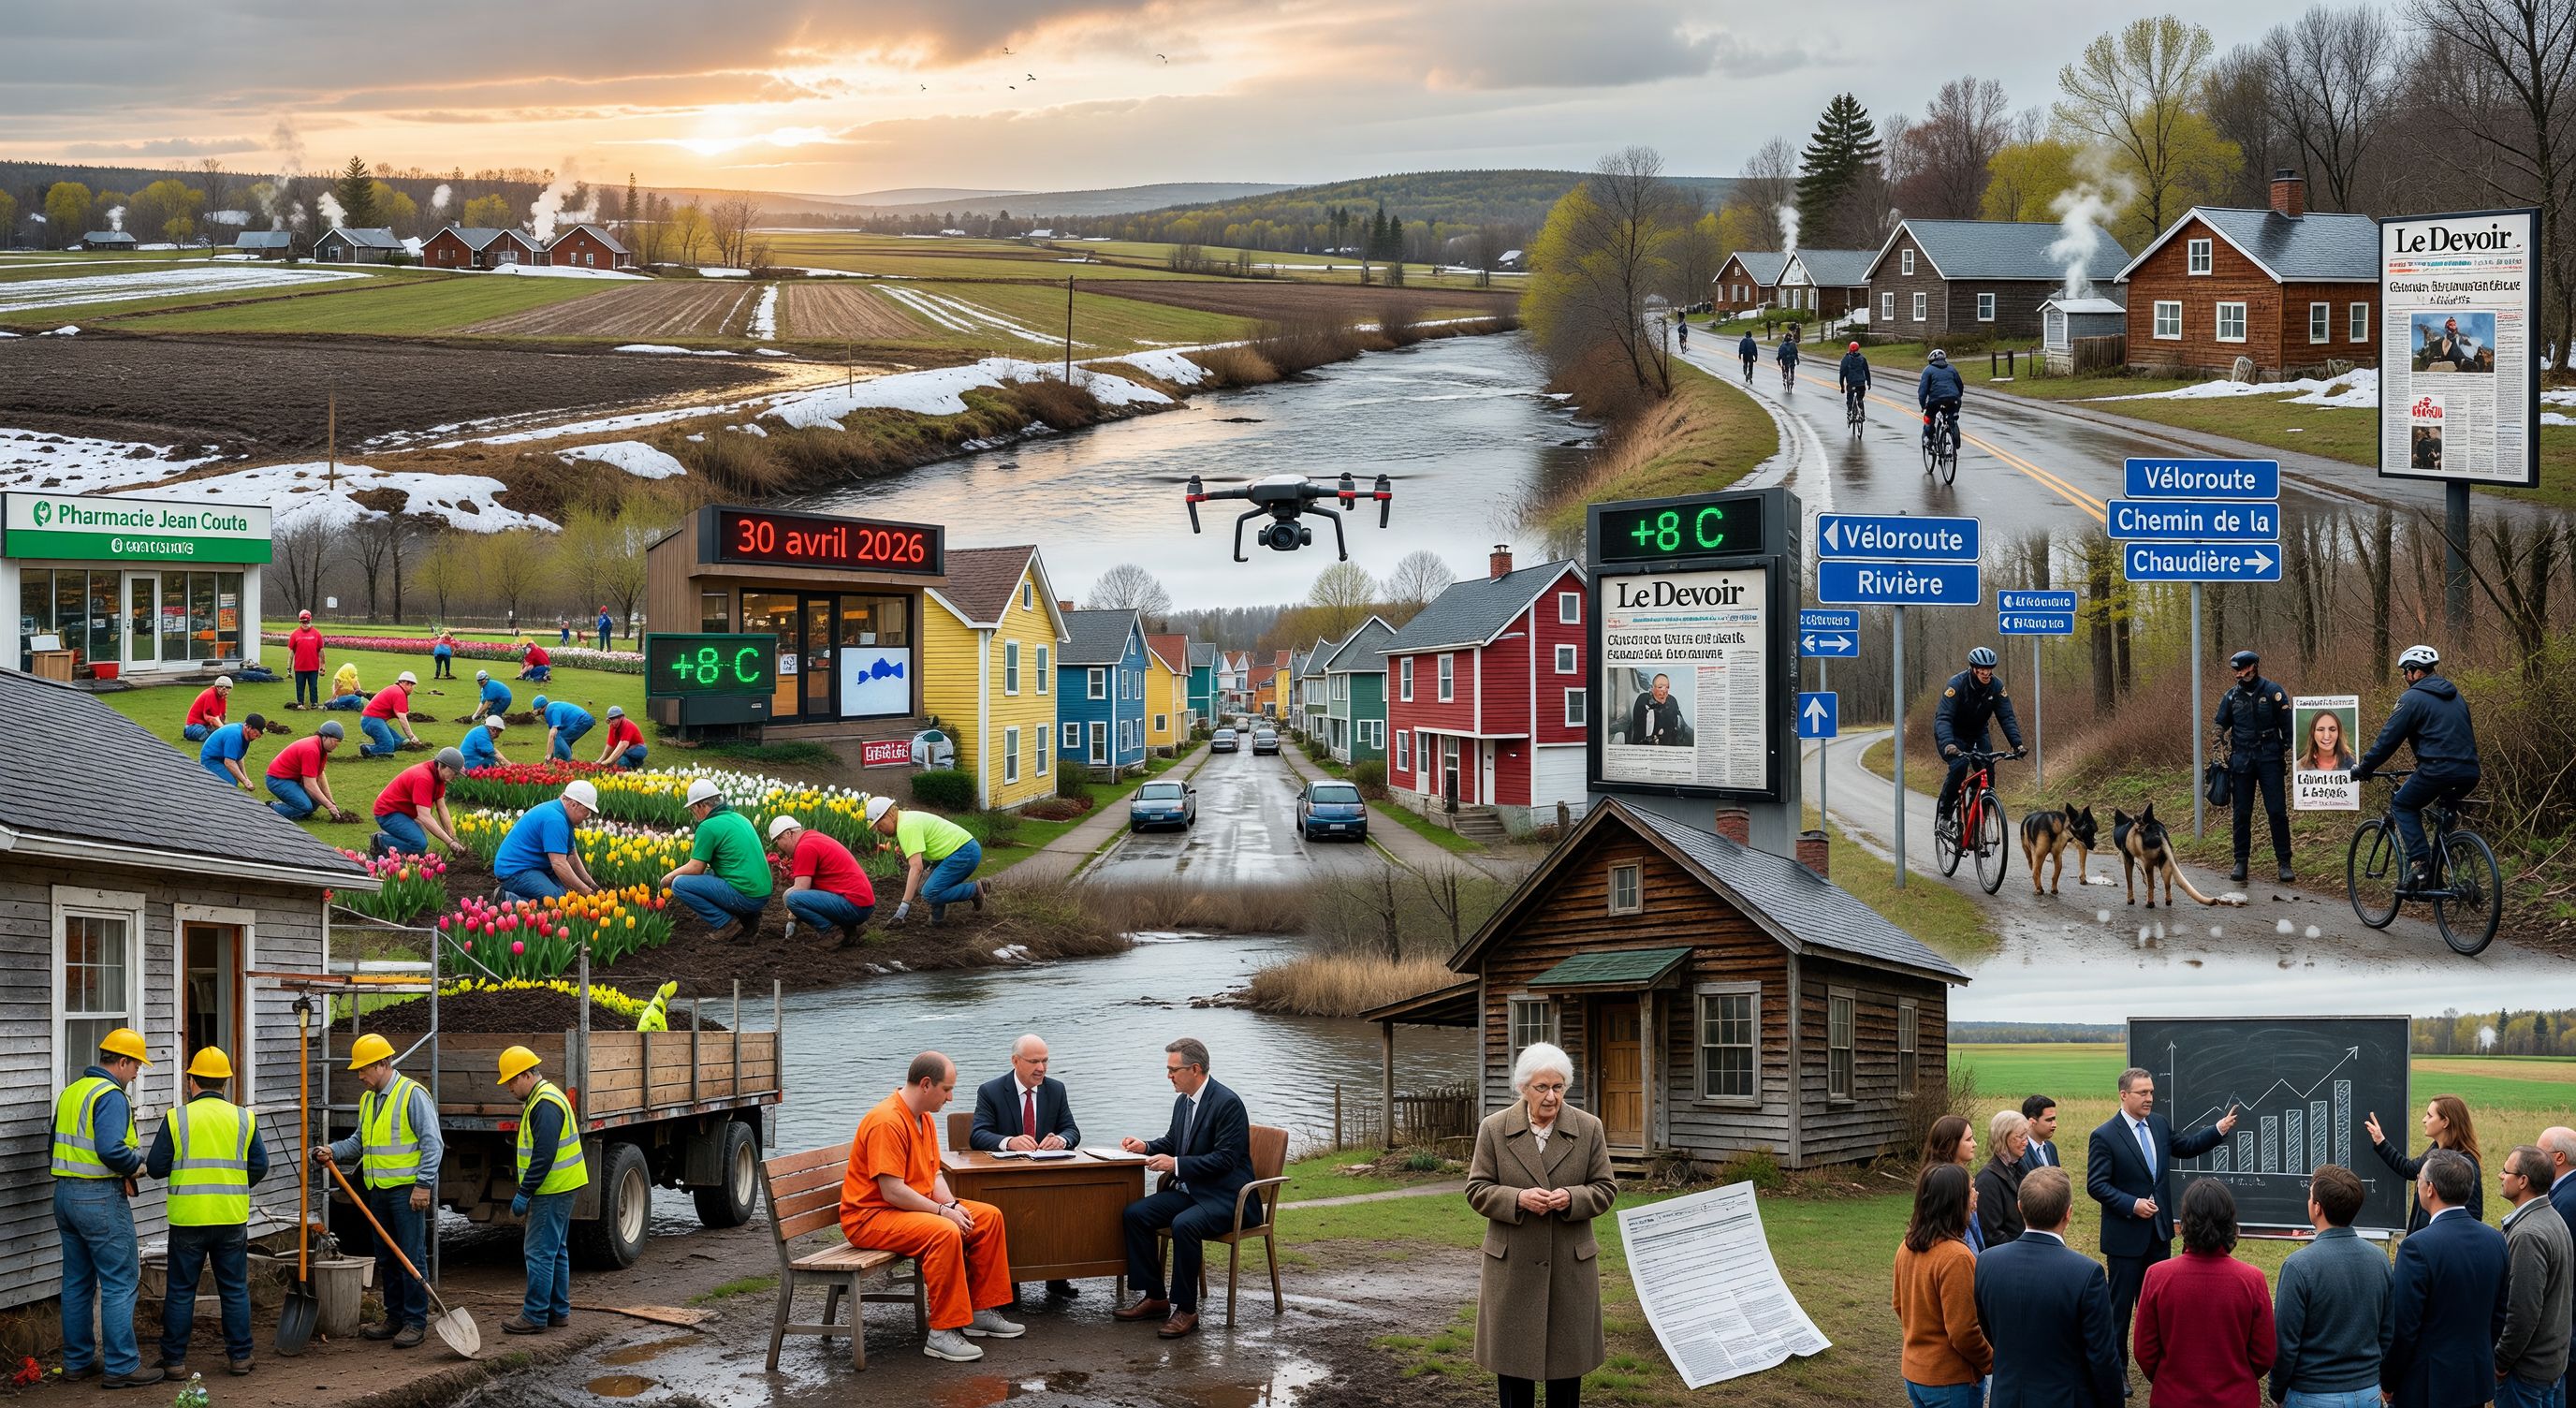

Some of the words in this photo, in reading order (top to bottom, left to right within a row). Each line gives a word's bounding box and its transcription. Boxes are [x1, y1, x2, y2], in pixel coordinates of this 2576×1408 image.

[2394, 227, 2426, 253] Le
[2428, 223, 2512, 252] Devoir
[2144, 466, 2256, 491] Véloroute
[59, 504, 154, 528] Pharmacie
[159, 509, 197, 529] Jean
[1631, 511, 1680, 551] +8
[1695, 506, 1724, 549] C
[2117, 507, 2203, 532] Chemin
[2214, 509, 2240, 532] de
[2250, 509, 2270, 533] la
[738, 519, 775, 553] 30
[785, 526, 847, 559] avril
[857, 529, 925, 563] 2026
[1844, 524, 1963, 550] Véloroute
[2133, 549, 2241, 573] Chaudière
[1616, 582, 1649, 609] Le
[1651, 578, 1745, 608] Devoir
[1858, 570, 1943, 595] Rivière
[671, 647, 719, 684] +8
[734, 647, 760, 683] C
